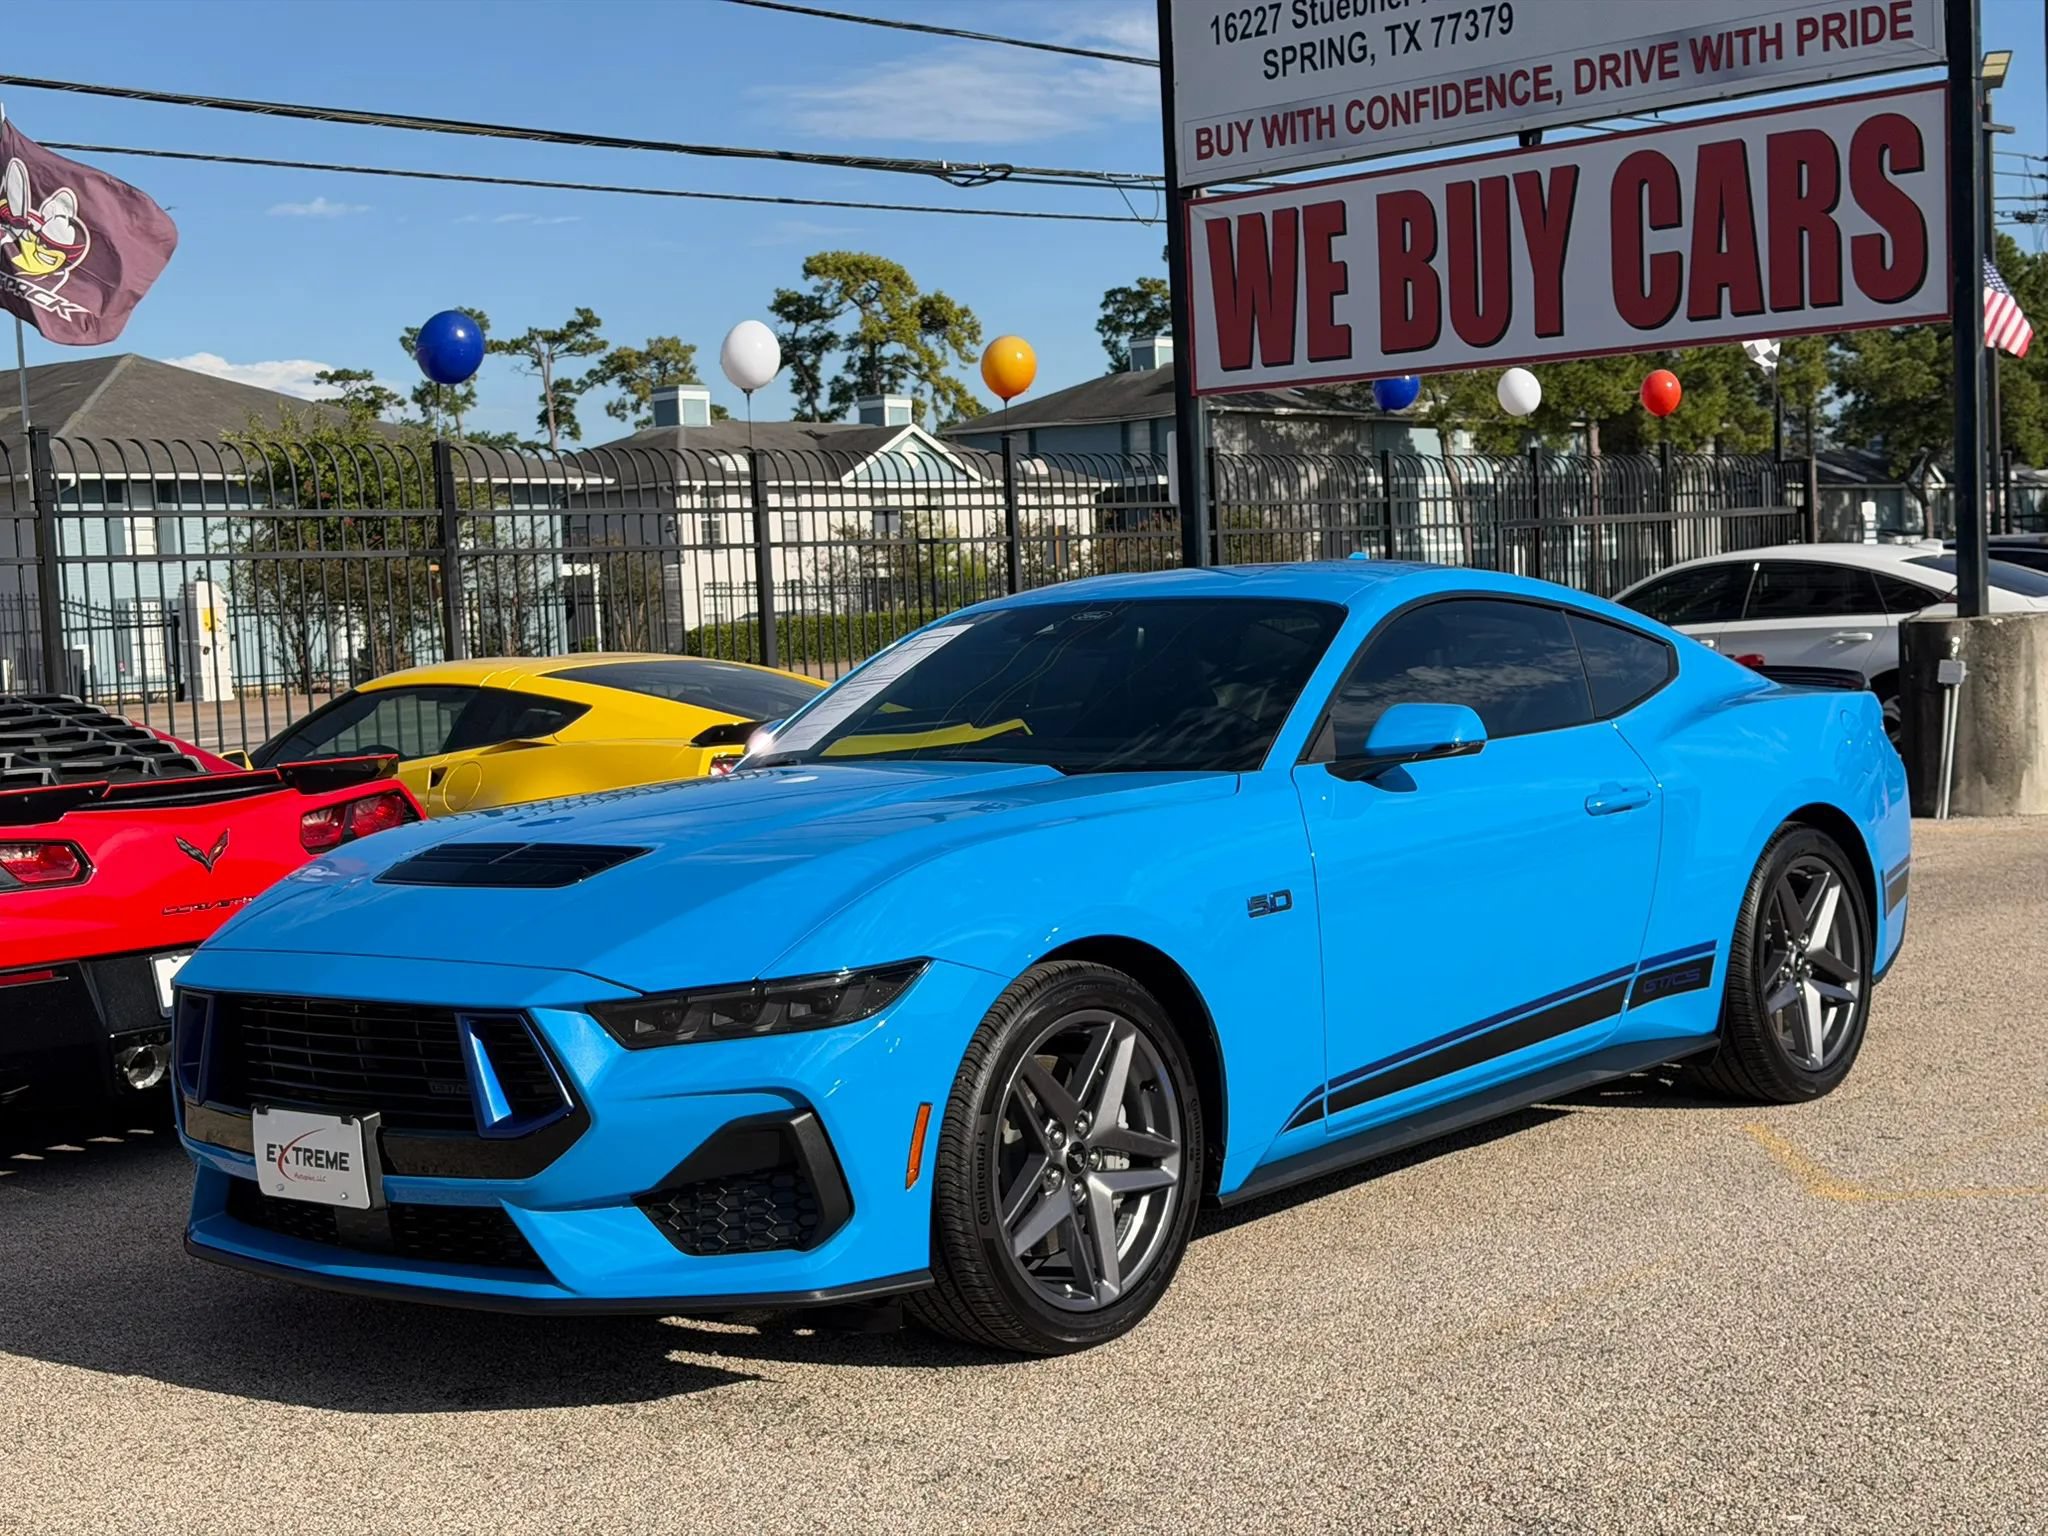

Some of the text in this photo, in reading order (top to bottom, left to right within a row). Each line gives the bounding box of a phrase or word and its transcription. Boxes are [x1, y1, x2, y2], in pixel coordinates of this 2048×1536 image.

[1210, 2, 1282, 45] 16227
[1263, 2, 1514, 80] SPRING, TX 77379
[1196, 0, 1914, 160] BUY WITH CONFIDENCE, DRIVE WITH PRIDE
[1205, 112, 1929, 372] WE BUY CARS
[266, 1143, 350, 1172] EXTREME
